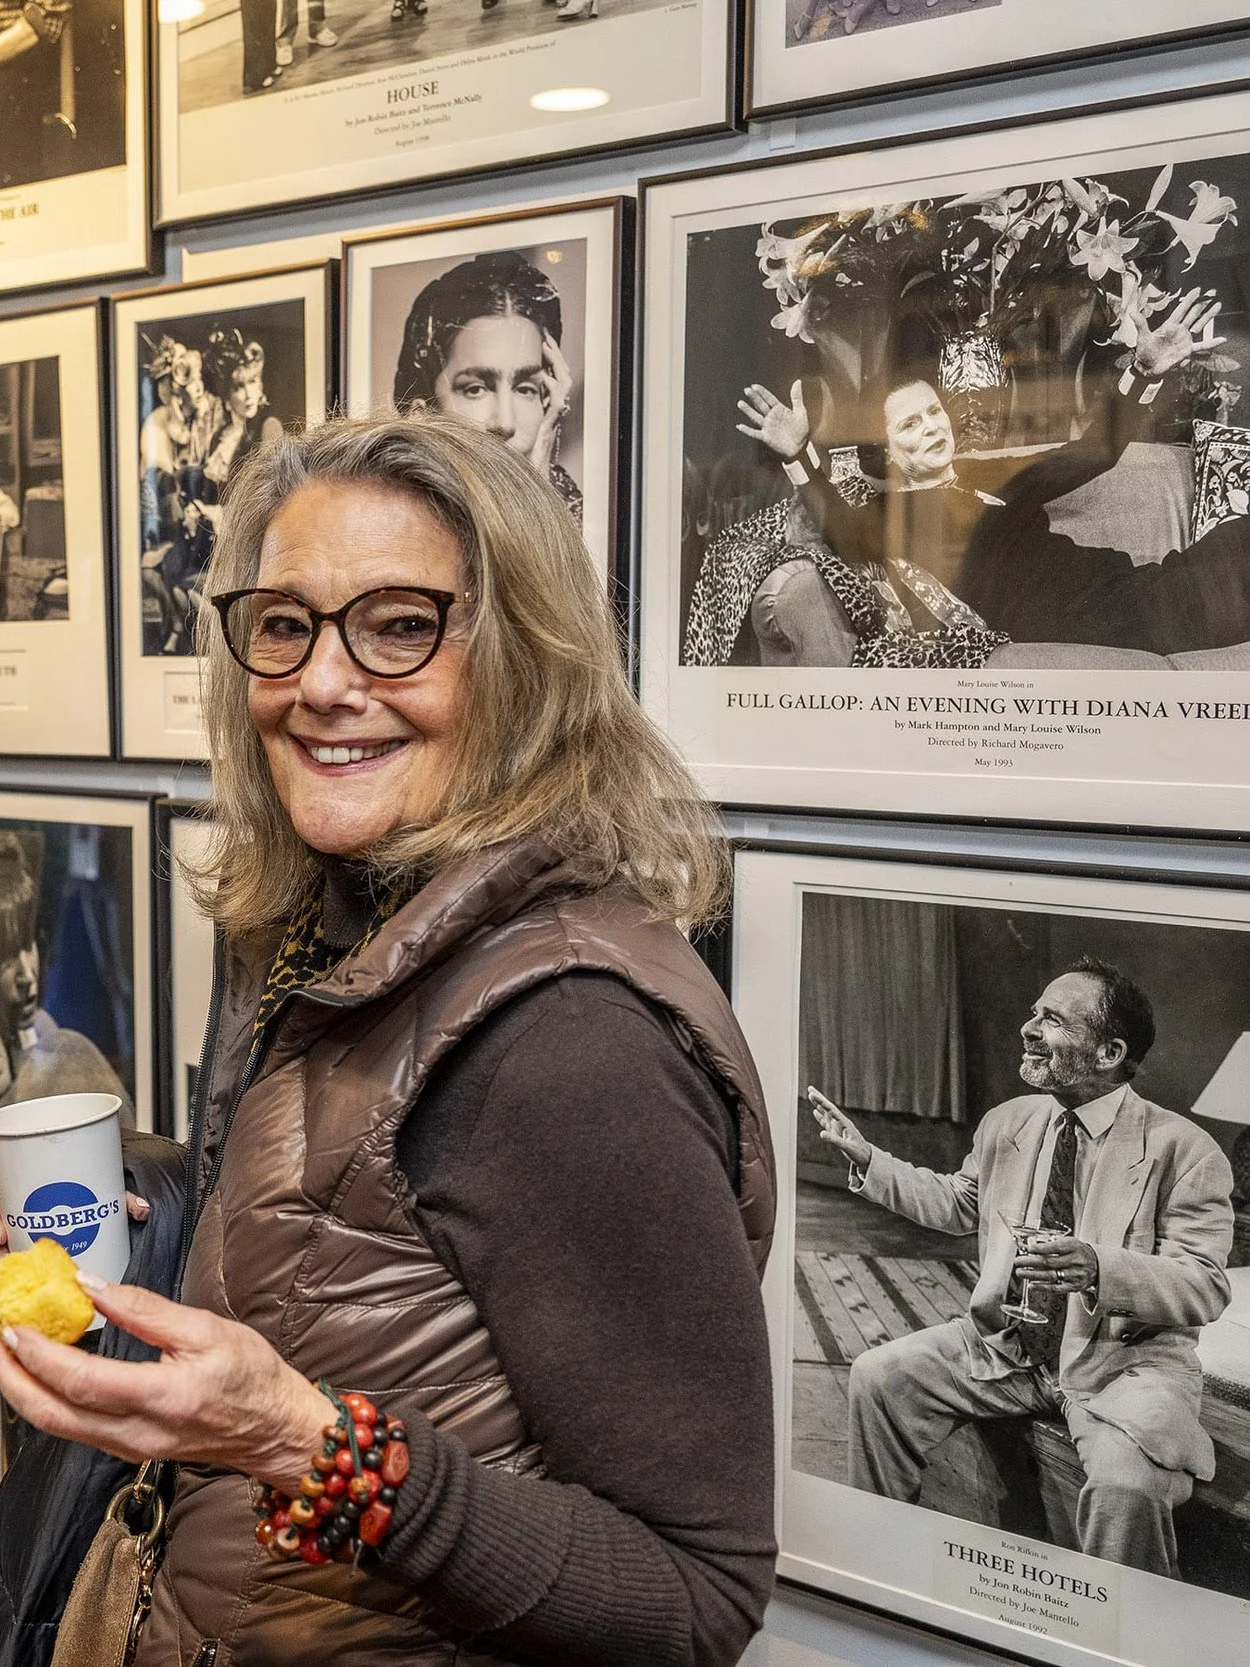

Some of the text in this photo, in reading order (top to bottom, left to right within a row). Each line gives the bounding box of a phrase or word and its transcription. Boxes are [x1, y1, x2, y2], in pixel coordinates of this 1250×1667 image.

[386, 81, 439, 104] HOUSE
[957, 680, 974, 689] Mary
[976, 680, 998, 688] Louise
[1000, 681, 1025, 689] Wilson
[727, 693, 774, 709] FULL
[779, 693, 863, 711] GALLOP:
[870, 696, 900, 712] AN
[906, 696, 1006, 715] EVENING
[1013, 698, 1079, 716] WITH
[1086, 700, 1170, 718] DIANA
[894, 720, 1101, 735] by Mark Hampton and Mary Louise Wilson
[928, 737, 1064, 751] Directed by Richard Mogavero
[975, 757, 1013, 768] May 1993
[6, 1199, 120, 1230] GOLDBERG'S
[71, 1241, 88, 1252] 1949
[1001, 1541, 1016, 1552] Ron
[1017, 1545, 1039, 1558] Rifkin
[943, 1541, 1108, 1603] THREE HOTELS
[979, 1573, 1069, 1609] by Jon Robin Baitz
[969, 1586, 1080, 1628] Directed by Joe Mantello
[999, 1613, 1048, 1635] August 1992
